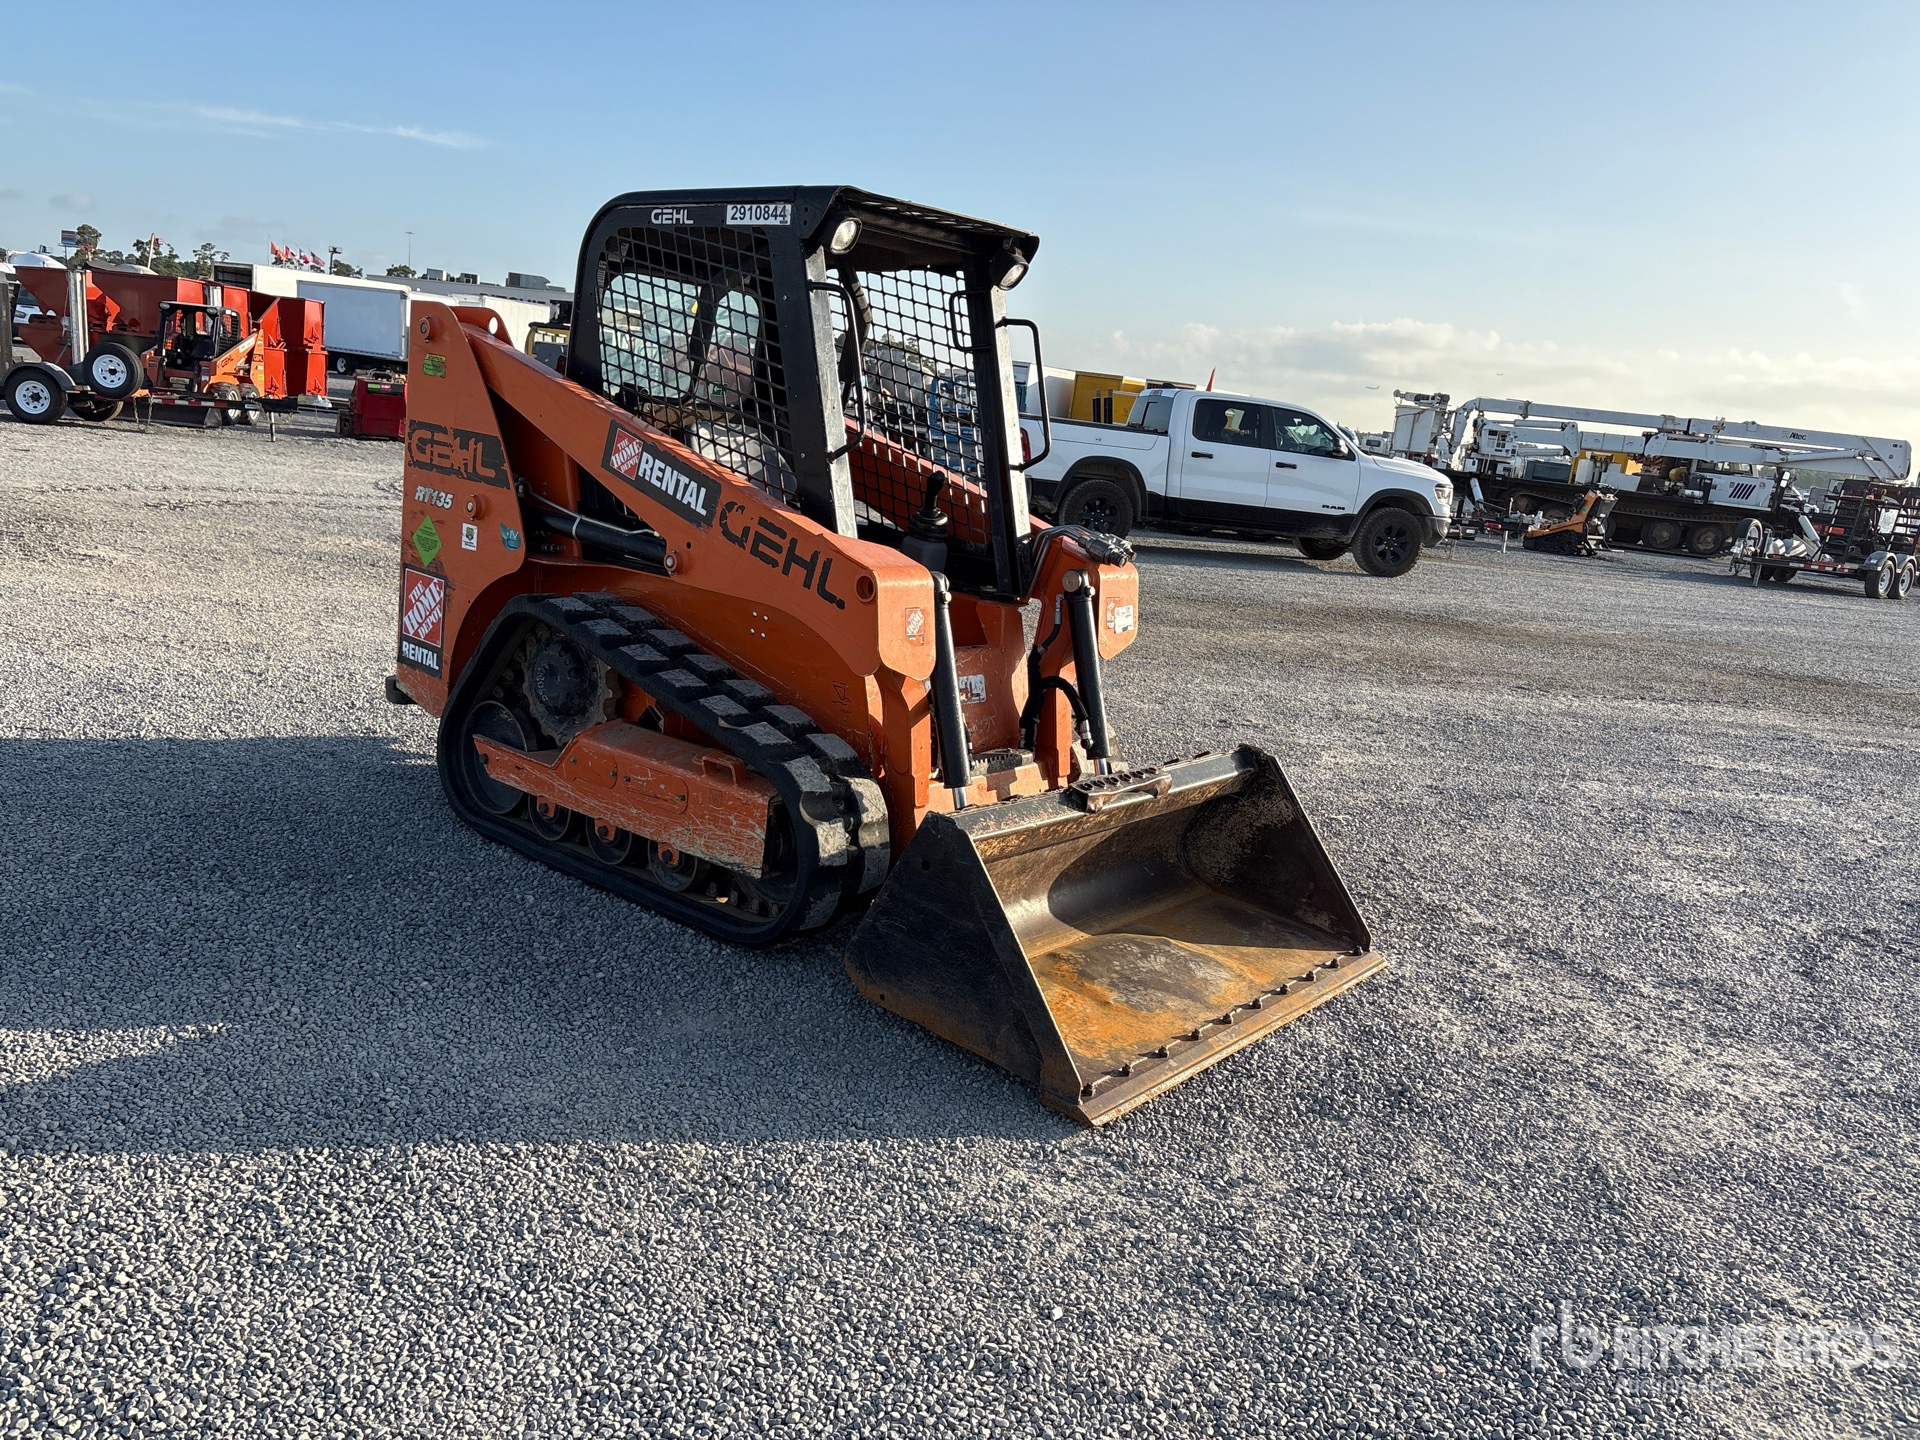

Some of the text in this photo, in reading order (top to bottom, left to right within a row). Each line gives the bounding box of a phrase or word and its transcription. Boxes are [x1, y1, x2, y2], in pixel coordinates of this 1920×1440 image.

[651, 209, 694, 224] GEHL
[731, 205, 787, 221] 2910844
[617, 438, 630, 450] THE
[1789, 432, 1807, 440] Altec
[411, 429, 496, 478] GEHL
[611, 440, 642, 468] HOME
[620, 456, 640, 473] DEPOT
[414, 485, 454, 509] RT135
[638, 451, 707, 517] RENTAL
[719, 500, 846, 610] GEHL
[408, 580, 426, 604] THE
[403, 578, 444, 635] HOME
[418, 604, 443, 640] DEPOT
[402, 640, 440, 671] RENTAL
